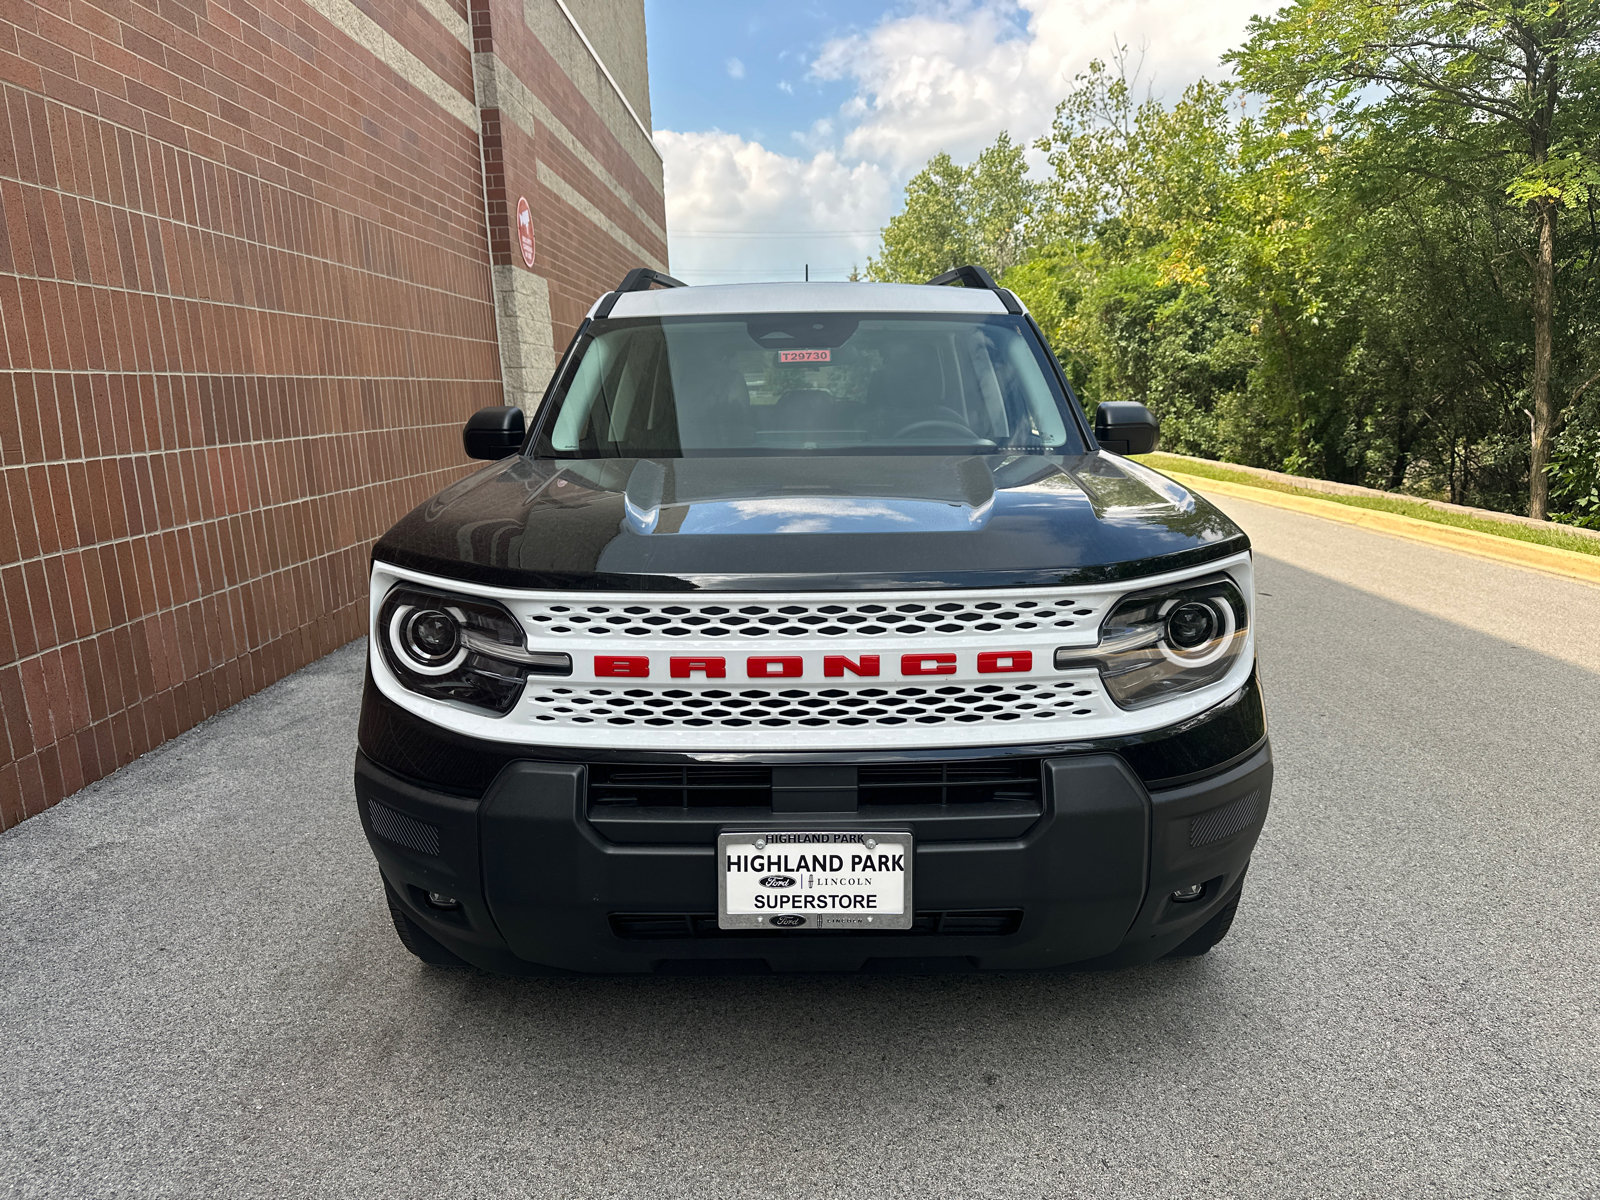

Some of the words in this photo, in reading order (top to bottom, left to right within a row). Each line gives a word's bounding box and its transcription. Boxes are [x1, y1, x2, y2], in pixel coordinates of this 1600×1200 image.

[783, 352, 828, 360] T29730
[594, 650, 1033, 678] BRONCO
[765, 833, 830, 844] HIGHLAND
[833, 833, 865, 844] PARK
[726, 854, 844, 873] HIGHLAND
[851, 854, 905, 872] PARK
[764, 876, 791, 888] Ford
[817, 878, 872, 886] LINCOLN
[754, 894, 878, 909] SUPERSTORE
[775, 915, 801, 927] Ford
